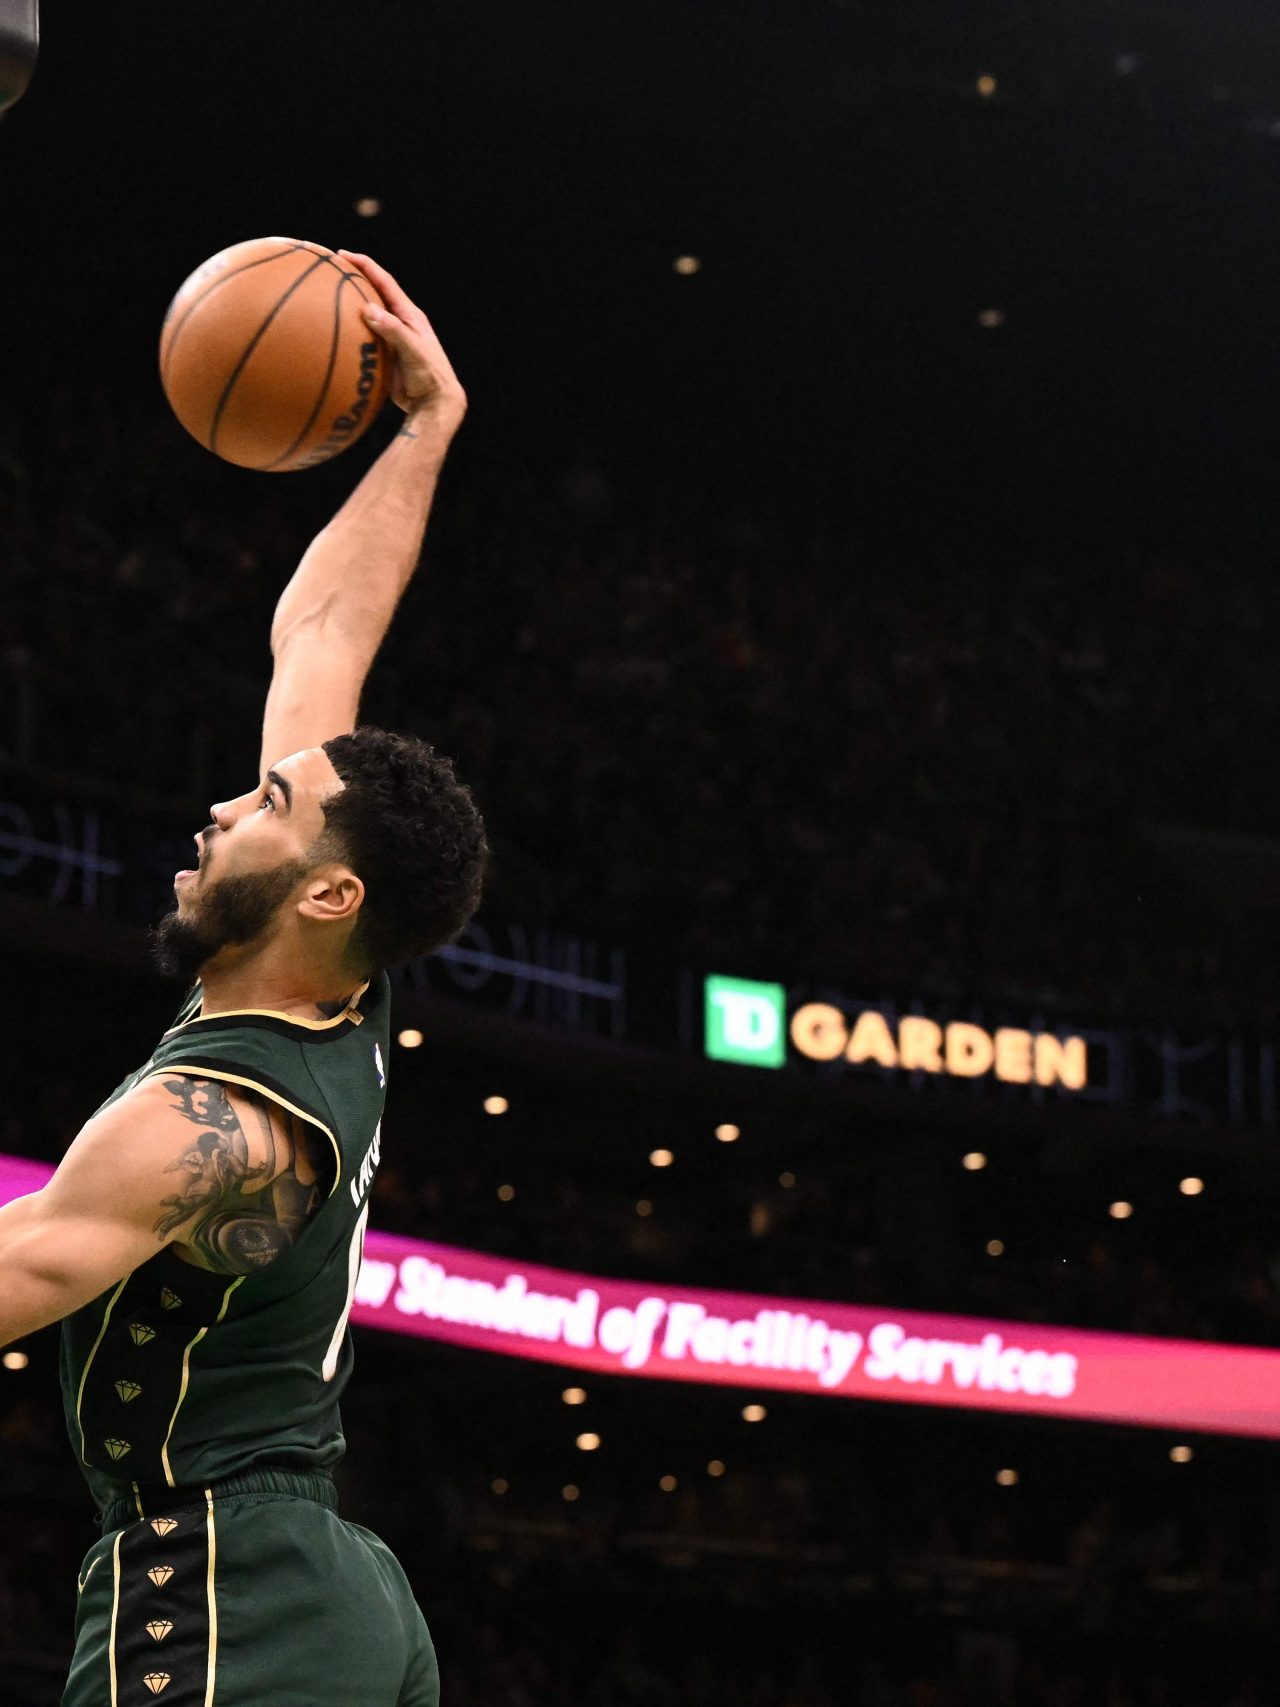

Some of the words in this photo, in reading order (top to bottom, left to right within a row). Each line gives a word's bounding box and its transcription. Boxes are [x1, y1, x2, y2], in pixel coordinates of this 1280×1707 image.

[712, 989, 781, 1051] TD
[790, 1002, 1088, 1091] GARDEN
[394, 1256, 599, 1348] Standard
[598, 1297, 668, 1369] of
[660, 1302, 863, 1388] Facility
[863, 1323, 1079, 1398] Services
